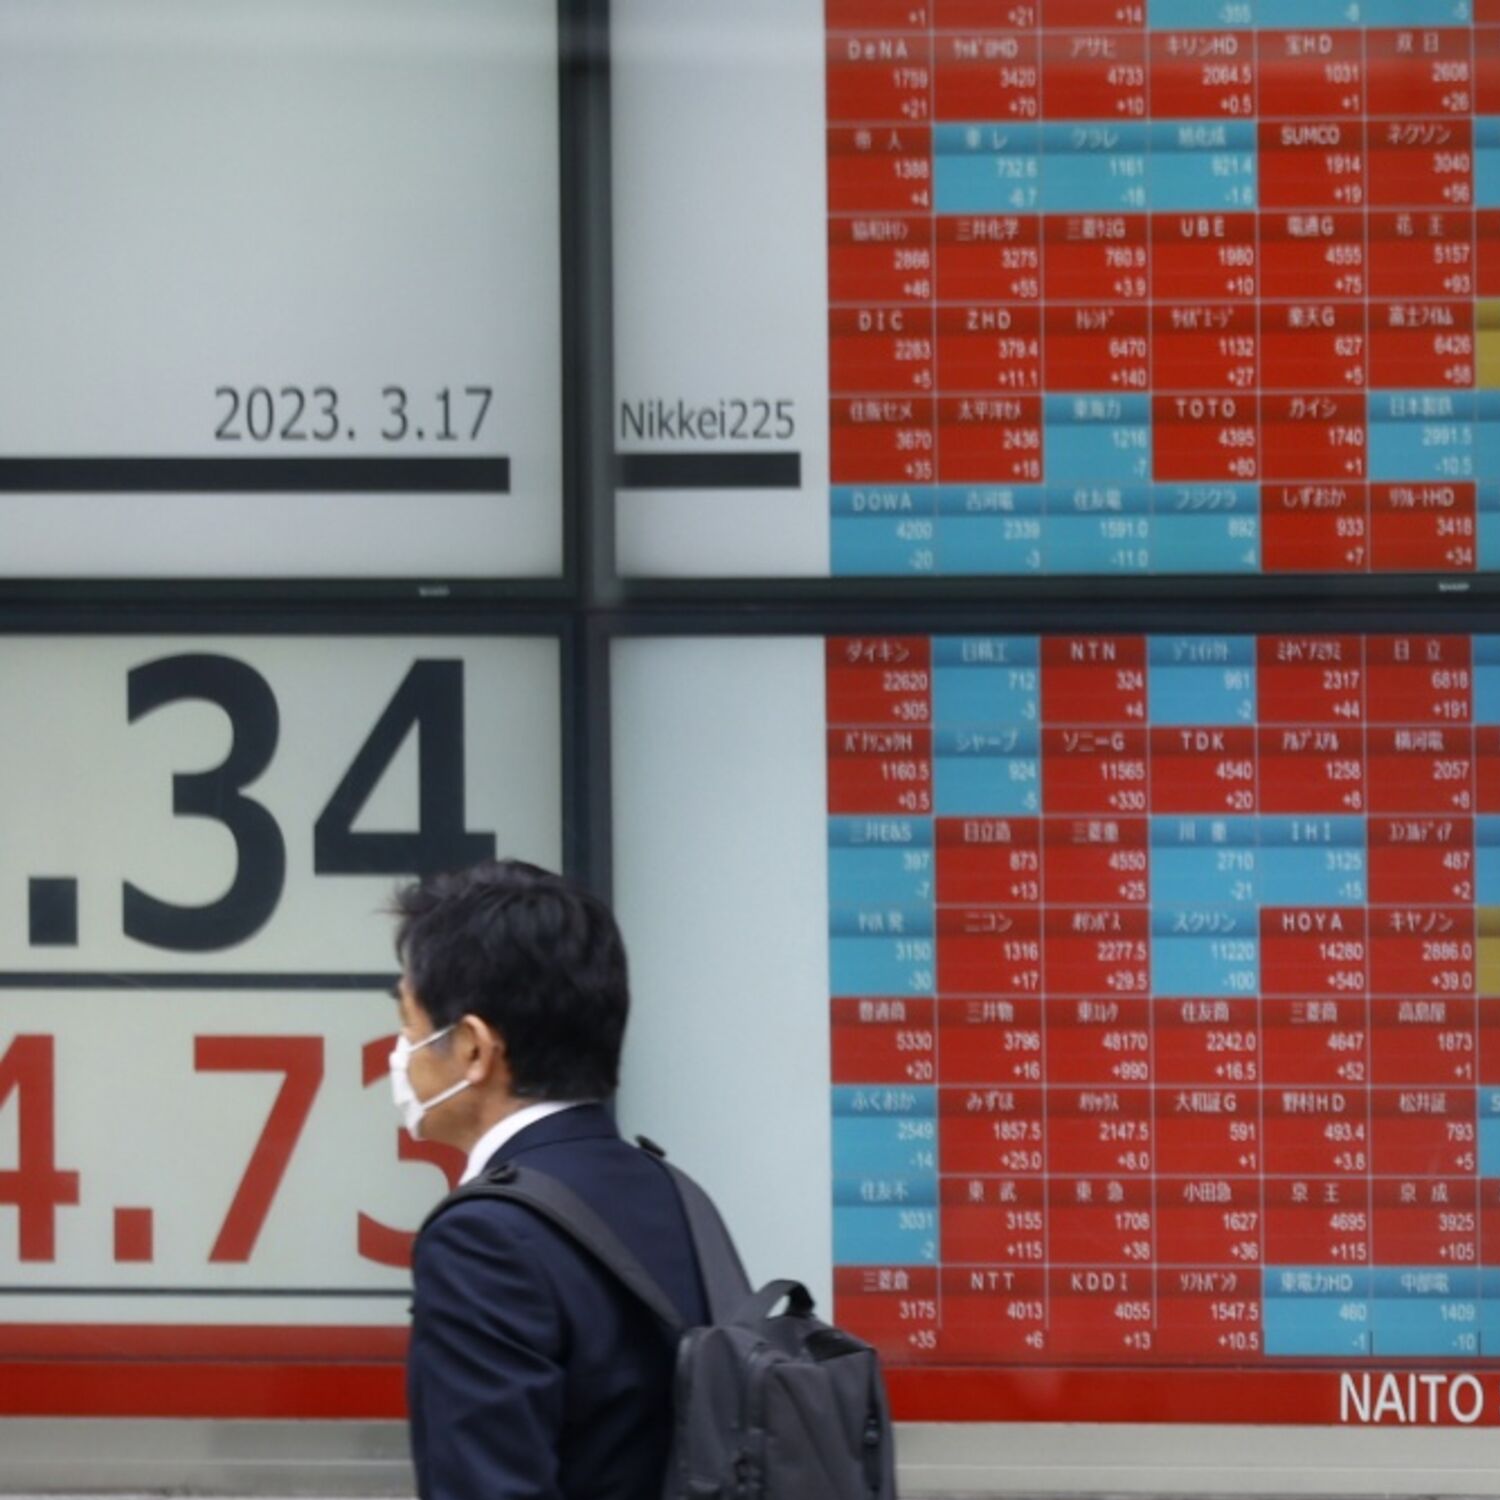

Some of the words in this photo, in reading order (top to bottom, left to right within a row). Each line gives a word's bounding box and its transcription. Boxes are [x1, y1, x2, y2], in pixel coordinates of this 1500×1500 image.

[1282, 125, 1340, 146] SUMCO
[1388, 124, 1450, 144] ネクソン
[1327, 154, 1361, 174] 1914
[858, 310, 903, 331] DIC
[215, 387, 355, 441] 2023.
[383, 387, 493, 441] 3.17
[621, 399, 795, 440] Nikkei225
[852, 490, 912, 512] DOWA
[1071, 642, 1116, 660] NTN
[1115, 671, 1144, 690] 324
[1323, 670, 1359, 689] 2317
[1434, 700, 1468, 718] +191
[1063, 732, 1125, 751] ソニーG
[1107, 792, 1145, 810] +330
[965, 913, 1013, 932] ニコン
[1282, 912, 1343, 931] HOYA
[967, 1091, 1014, 1111] みずほ
[1445, 1123, 1474, 1141] 793
[1223, 1212, 1257, 1231] 1627
[970, 1272, 1013, 1290] NTT
[1071, 1272, 1127, 1291] KDDI
[900, 1300, 936, 1319] 3175
[1007, 1301, 1043, 1320] 4013
[1219, 1331, 1259, 1350] +10.5
[1341, 1373, 1483, 1423] NAITO
